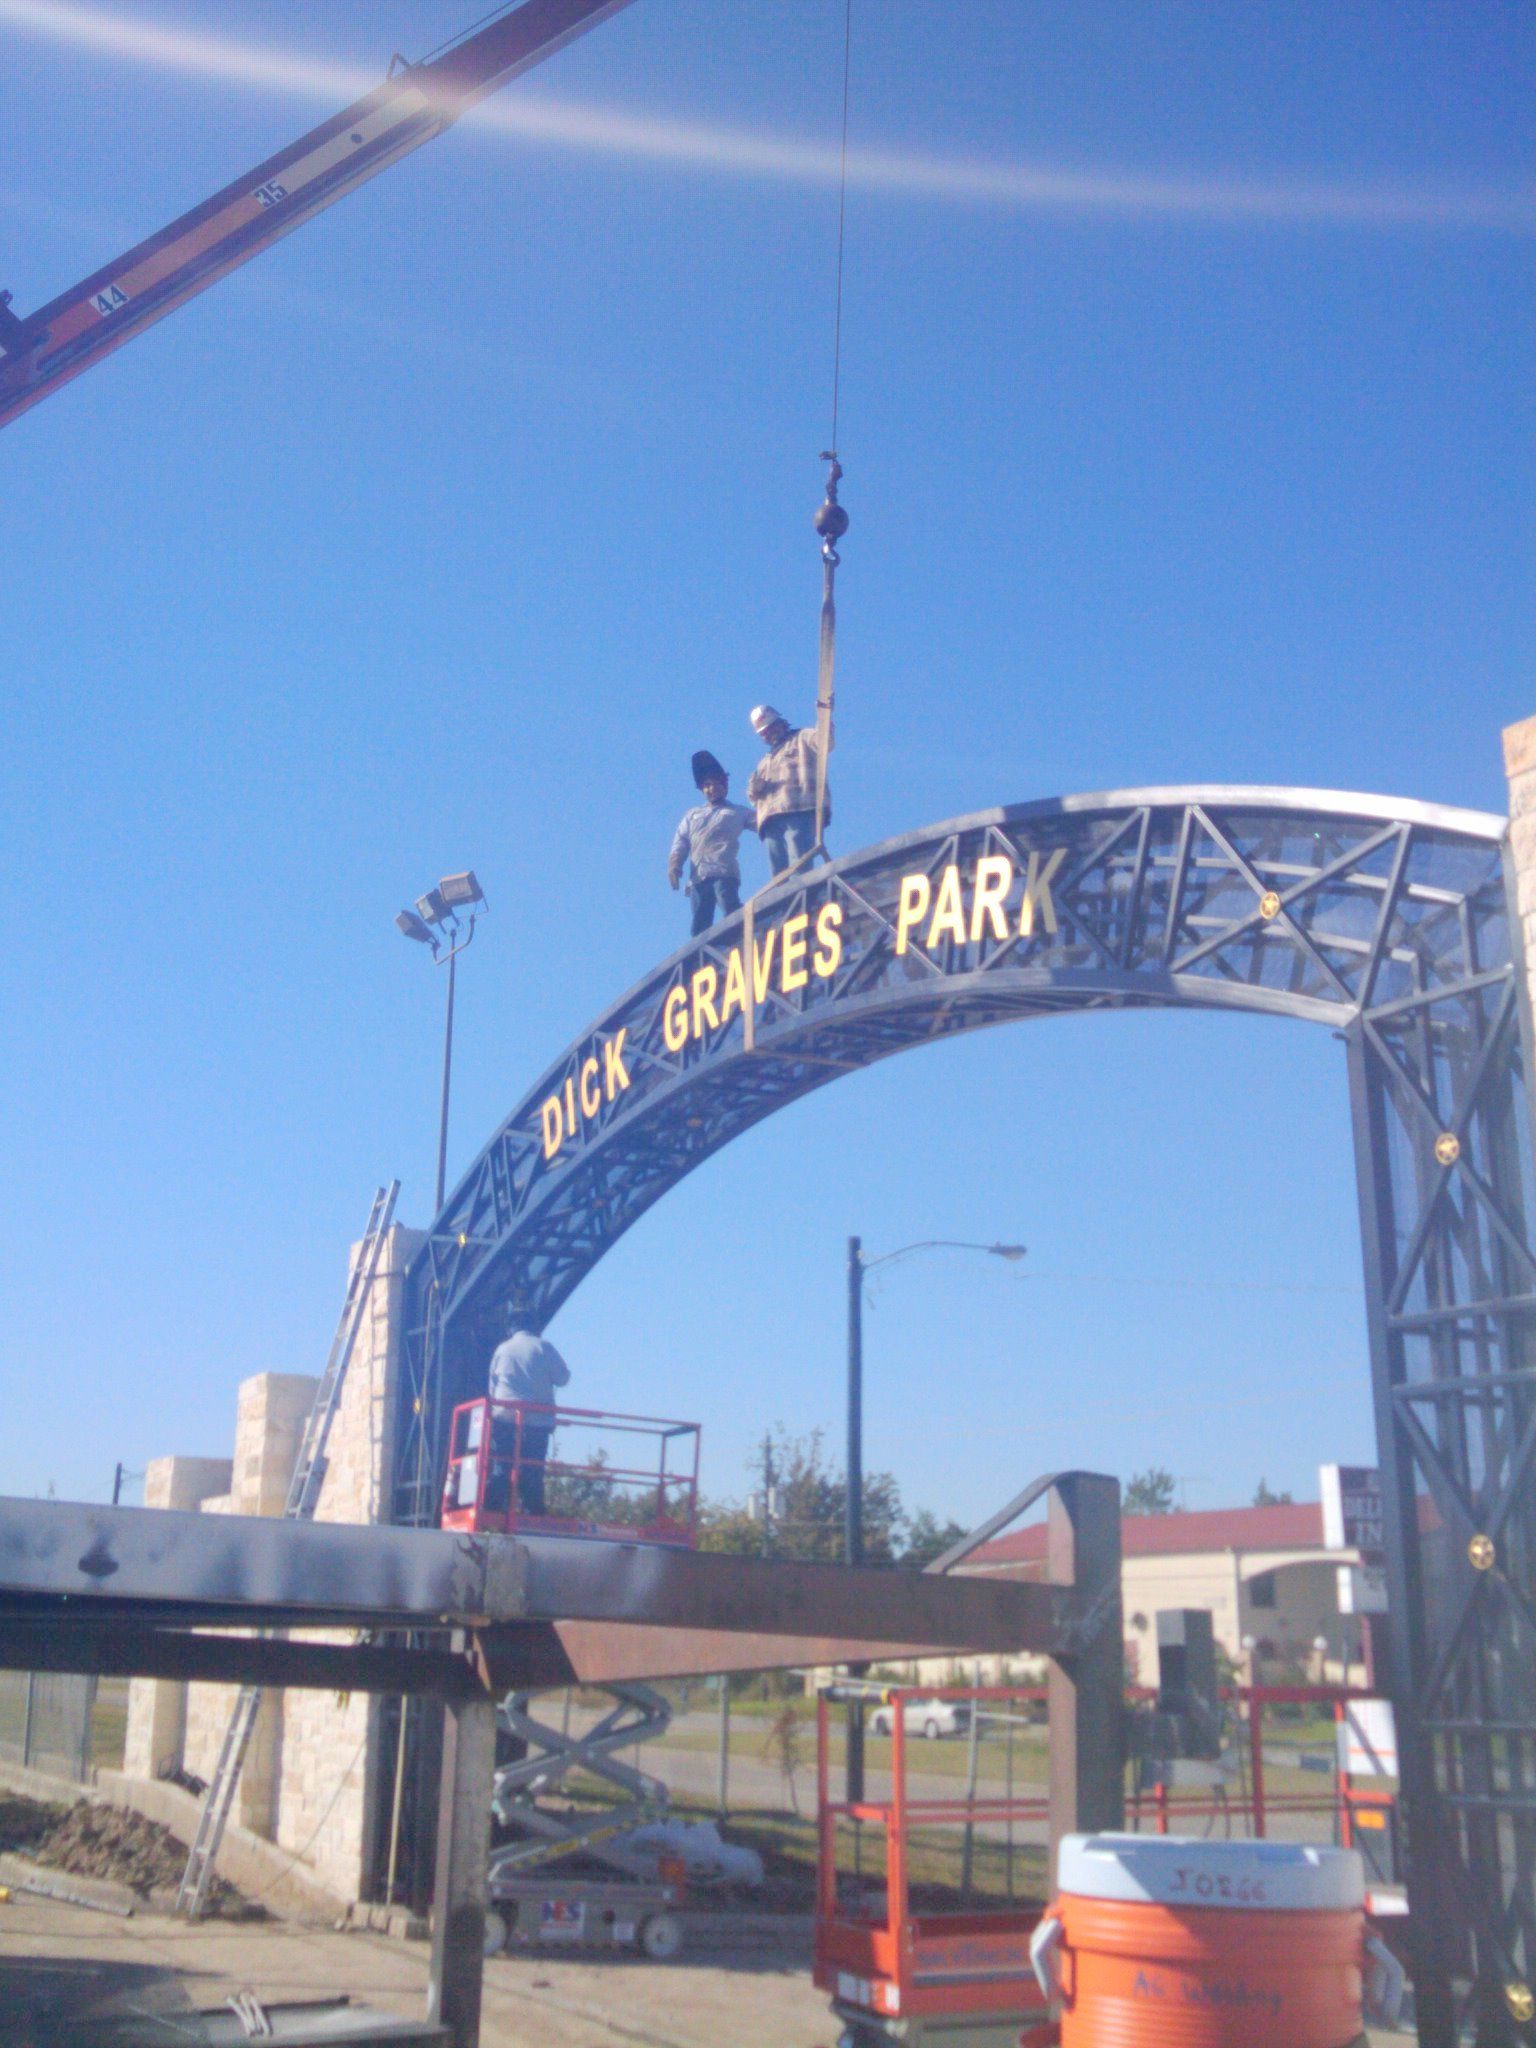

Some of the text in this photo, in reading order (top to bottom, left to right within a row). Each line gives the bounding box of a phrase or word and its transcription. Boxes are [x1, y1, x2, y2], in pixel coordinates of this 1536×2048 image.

[254, 179, 289, 208] 35
[96, 284, 129, 315] 44
[541, 847, 1068, 1161] DICK GRAVES PARK
